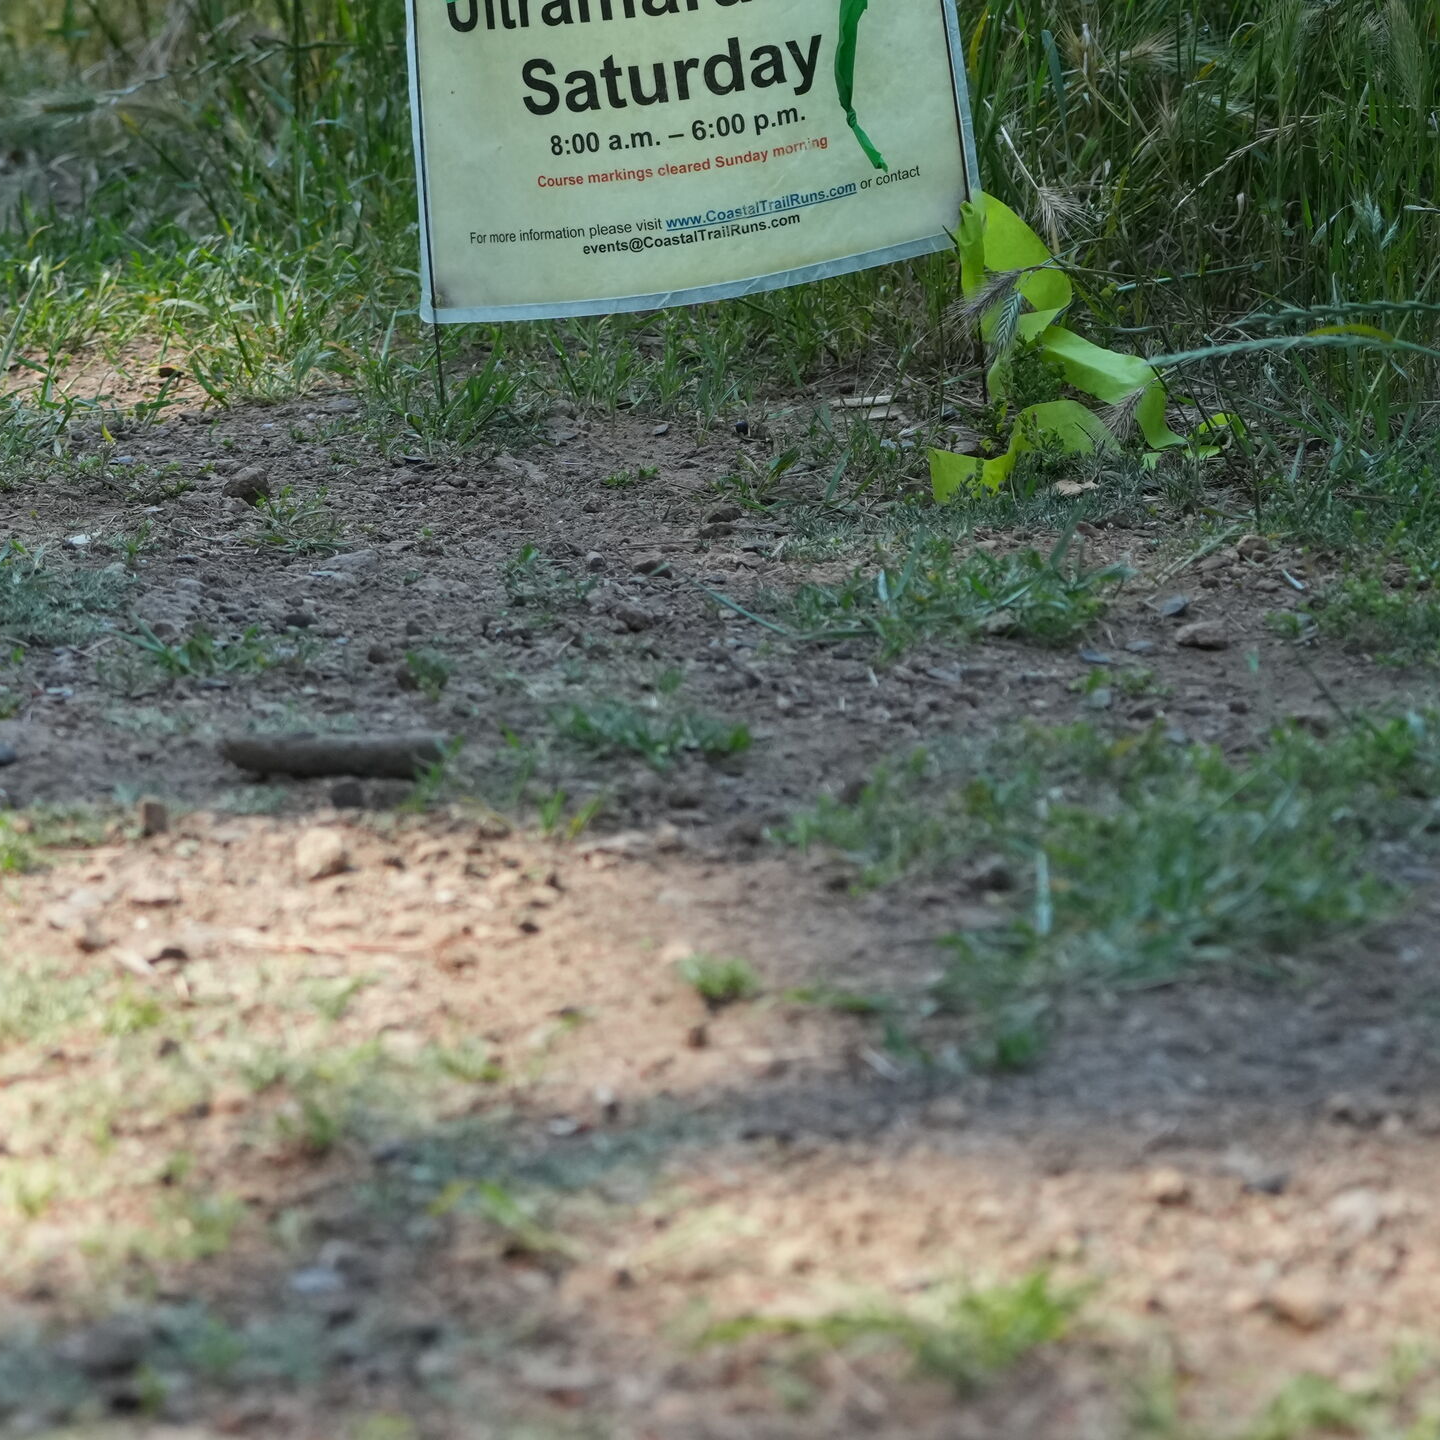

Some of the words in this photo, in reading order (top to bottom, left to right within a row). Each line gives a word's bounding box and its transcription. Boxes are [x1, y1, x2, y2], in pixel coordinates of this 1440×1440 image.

[522, 34, 822, 116] Saturday
[550, 131, 600, 156] 8:00
[608, 130, 661, 151] a.m.
[691, 113, 745, 141] 6:00
[753, 106, 806, 136] p.m.
[537, 175, 584, 188] Course
[587, 167, 654, 184] markings
[657, 159, 711, 177] cleared
[715, 151, 768, 169] Sunday
[469, 231, 487, 244] For
[489, 231, 517, 243] more
[519, 225, 585, 242] information
[589, 221, 632, 239] please
[635, 217, 663, 232] visit
[666, 180, 857, 231] www.CoastalTrailRuns.com
[860, 177, 873, 190] or
[875, 165, 921, 186] contact
[582, 213, 801, 255] events@CoastalTrailRuns.com
